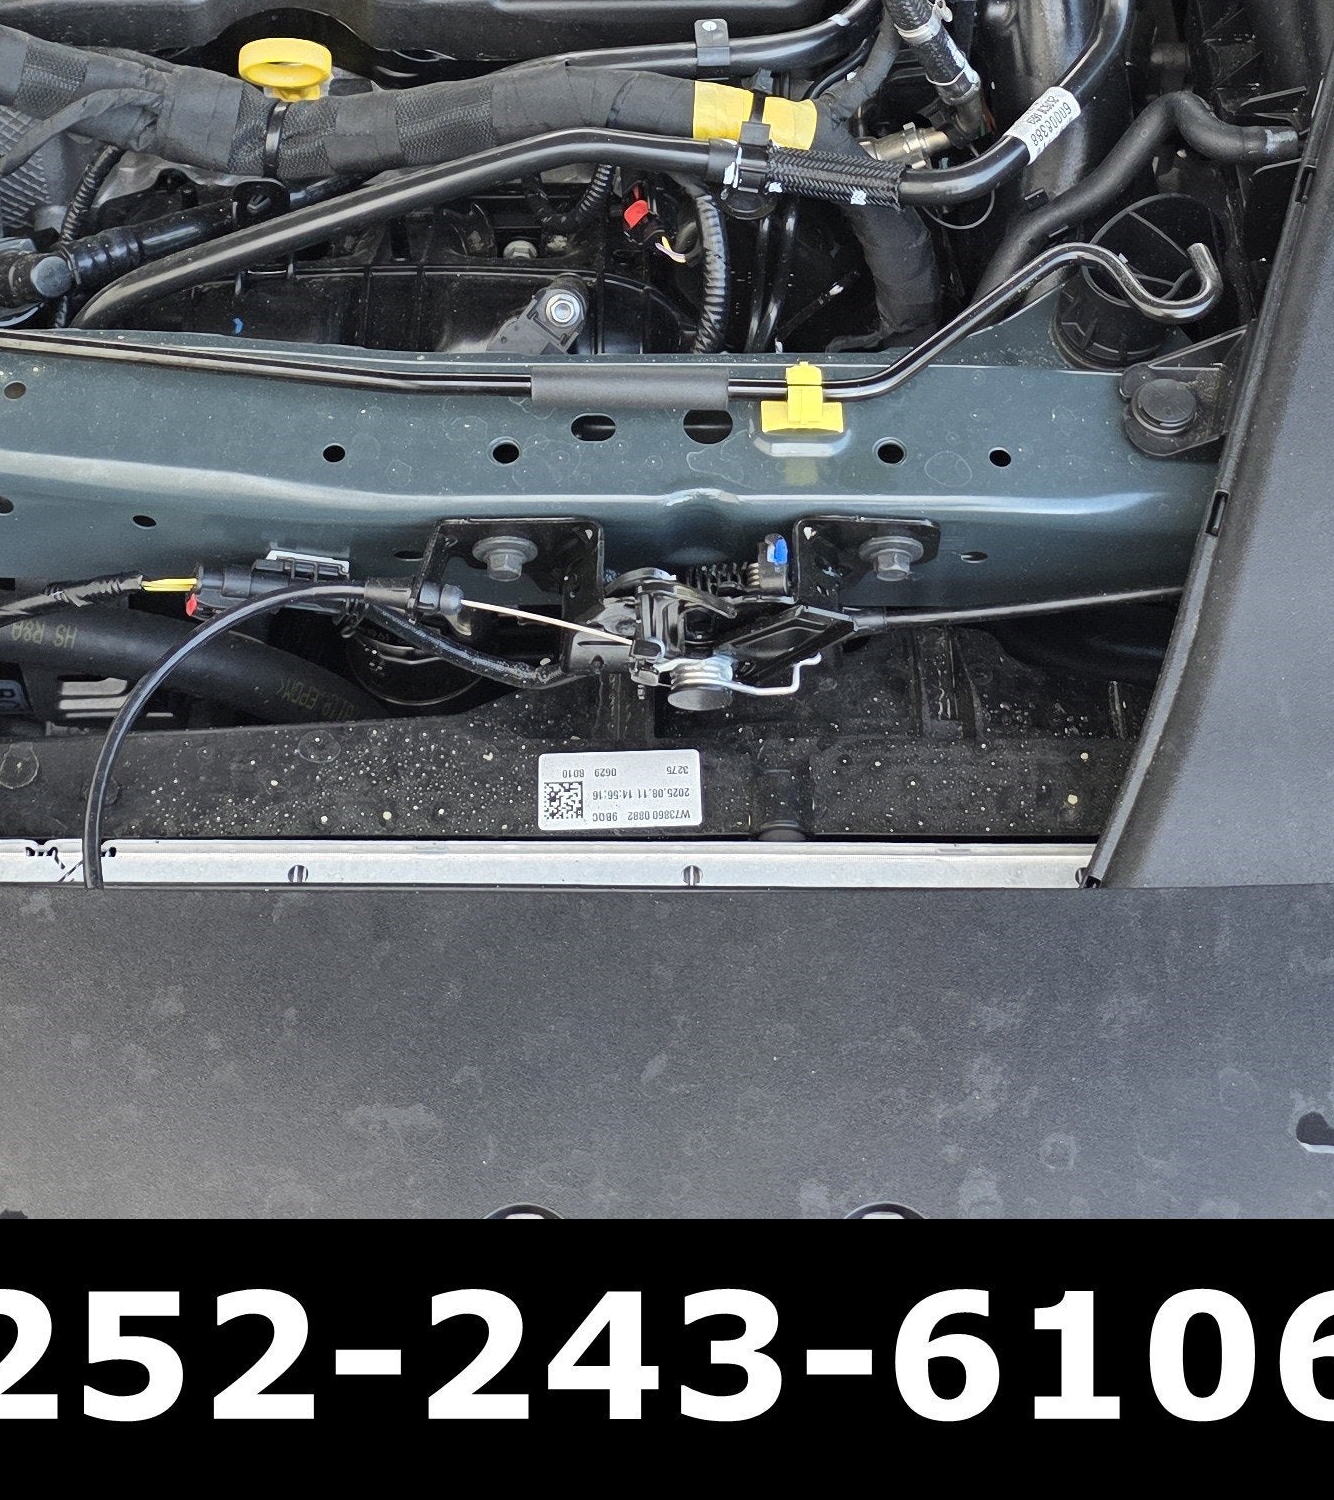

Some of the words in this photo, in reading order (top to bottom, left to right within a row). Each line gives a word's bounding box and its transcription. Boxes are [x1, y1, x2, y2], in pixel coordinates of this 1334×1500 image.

[562, 768, 585, 778] 8010
[594, 767, 617, 778] 0629
[666, 765, 689, 775] 3275
[592, 789, 633, 800] 14:56:16
[637, 787, 690, 799] 2025.08.11
